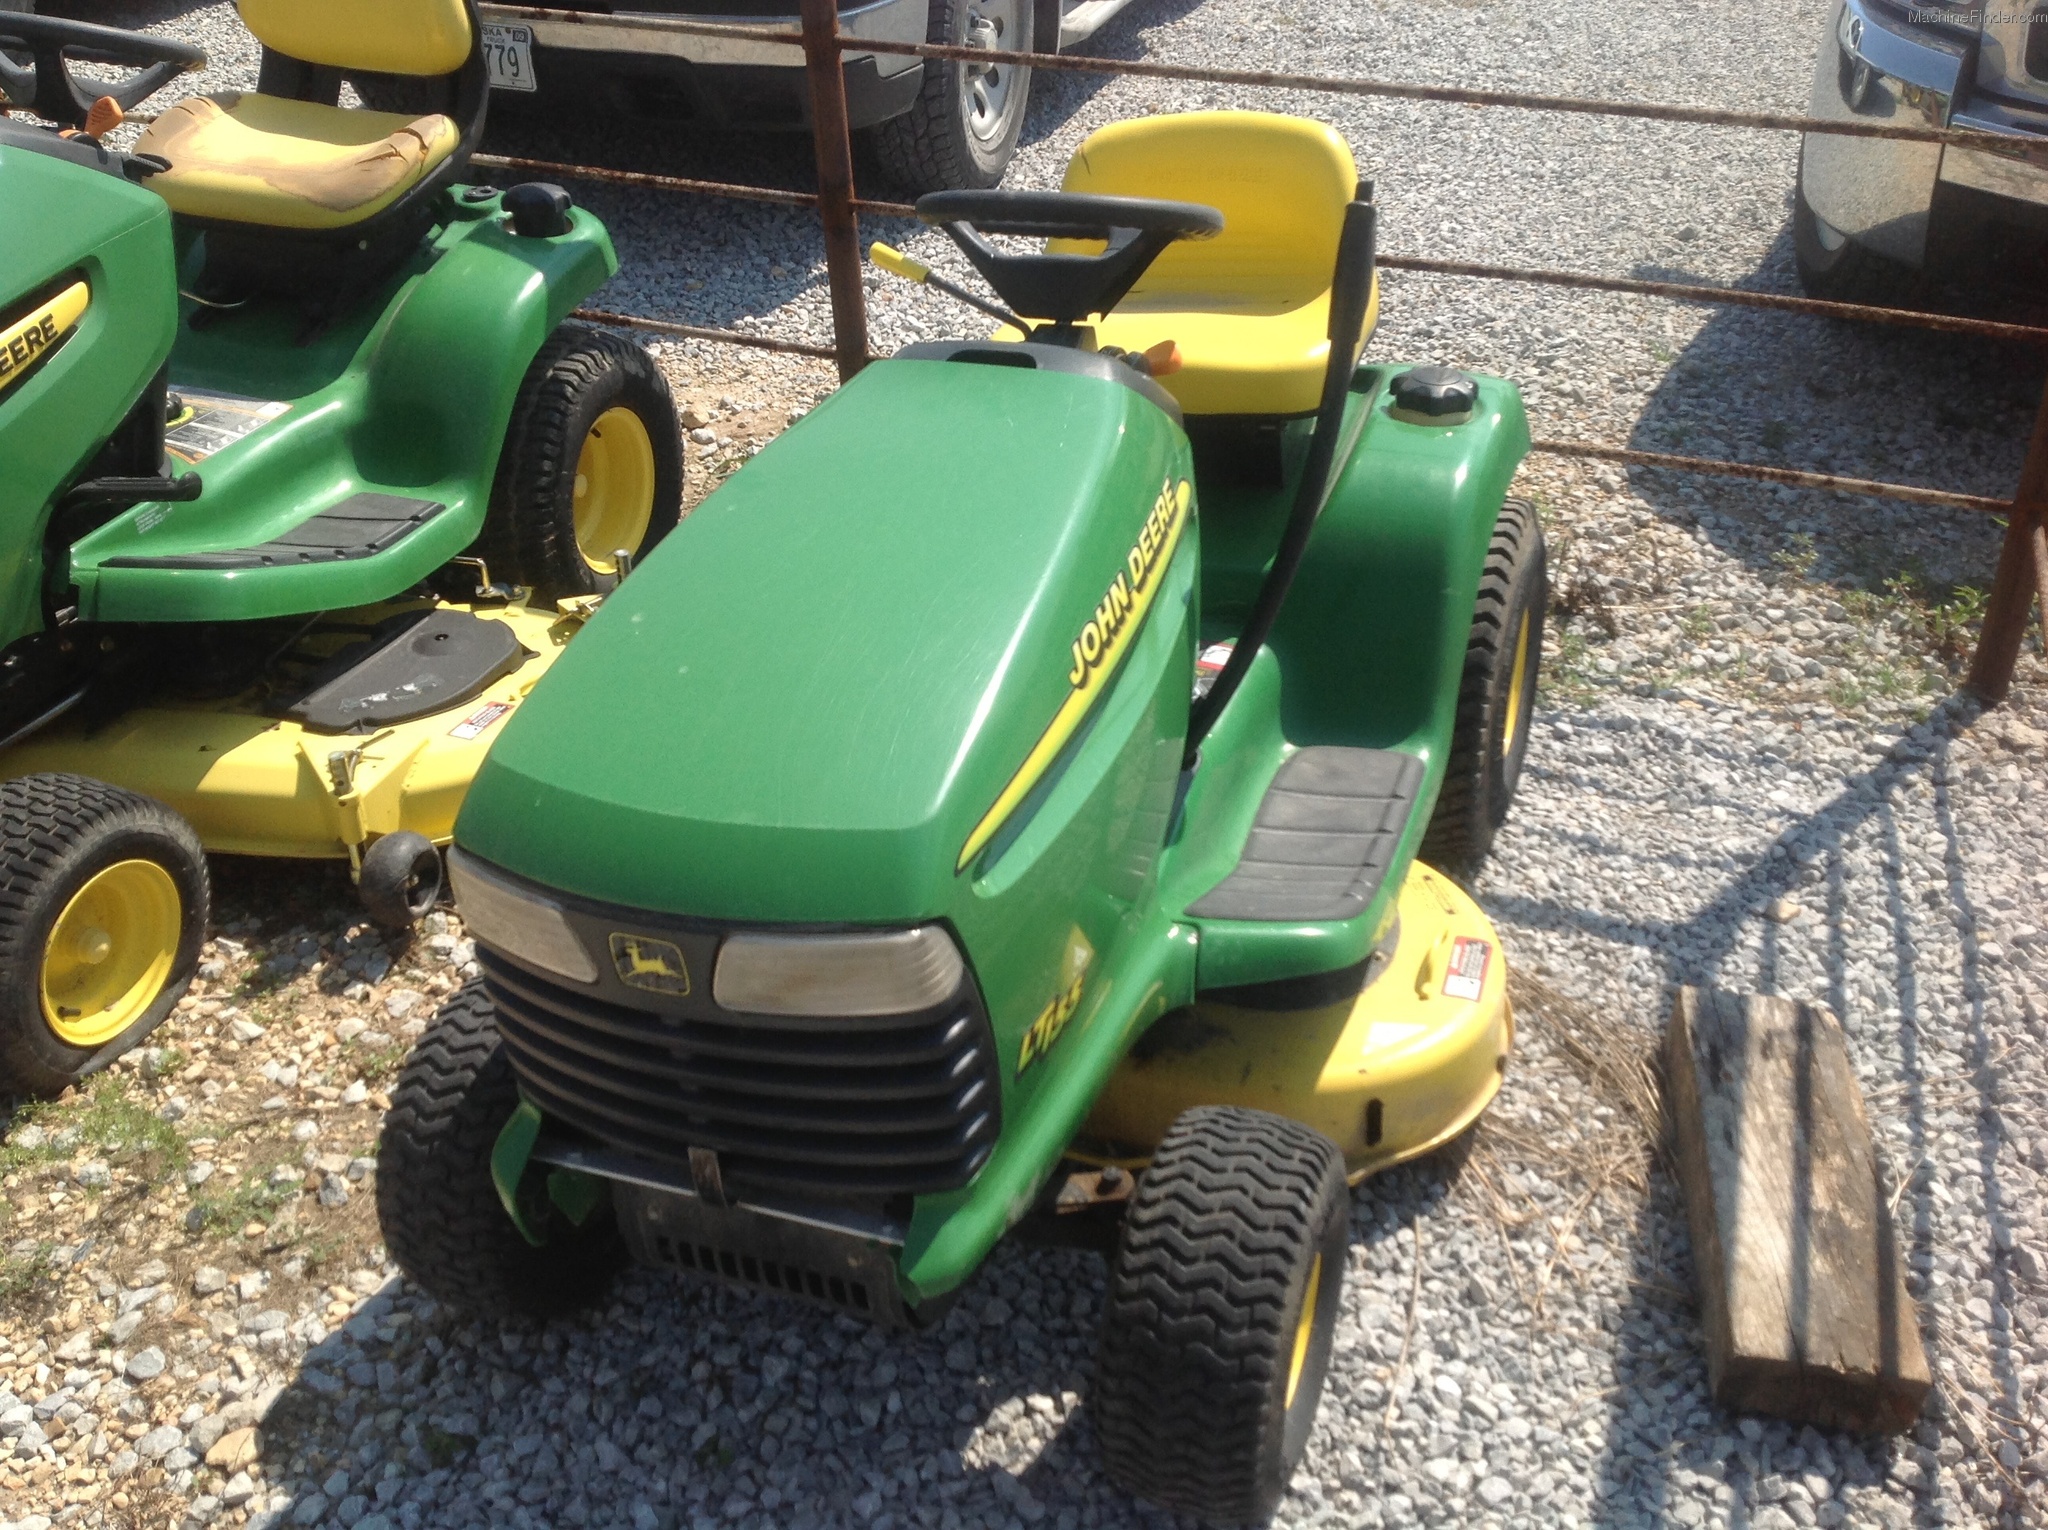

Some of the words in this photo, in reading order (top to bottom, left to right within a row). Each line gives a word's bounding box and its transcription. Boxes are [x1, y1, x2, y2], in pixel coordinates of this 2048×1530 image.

[482, 26, 502, 37] SKA
[483, 43, 520, 78] 779
[0, 313, 58, 377] EERE
[1069, 571, 1133, 688] JOHN
[1127, 477, 1178, 594] DEERE
